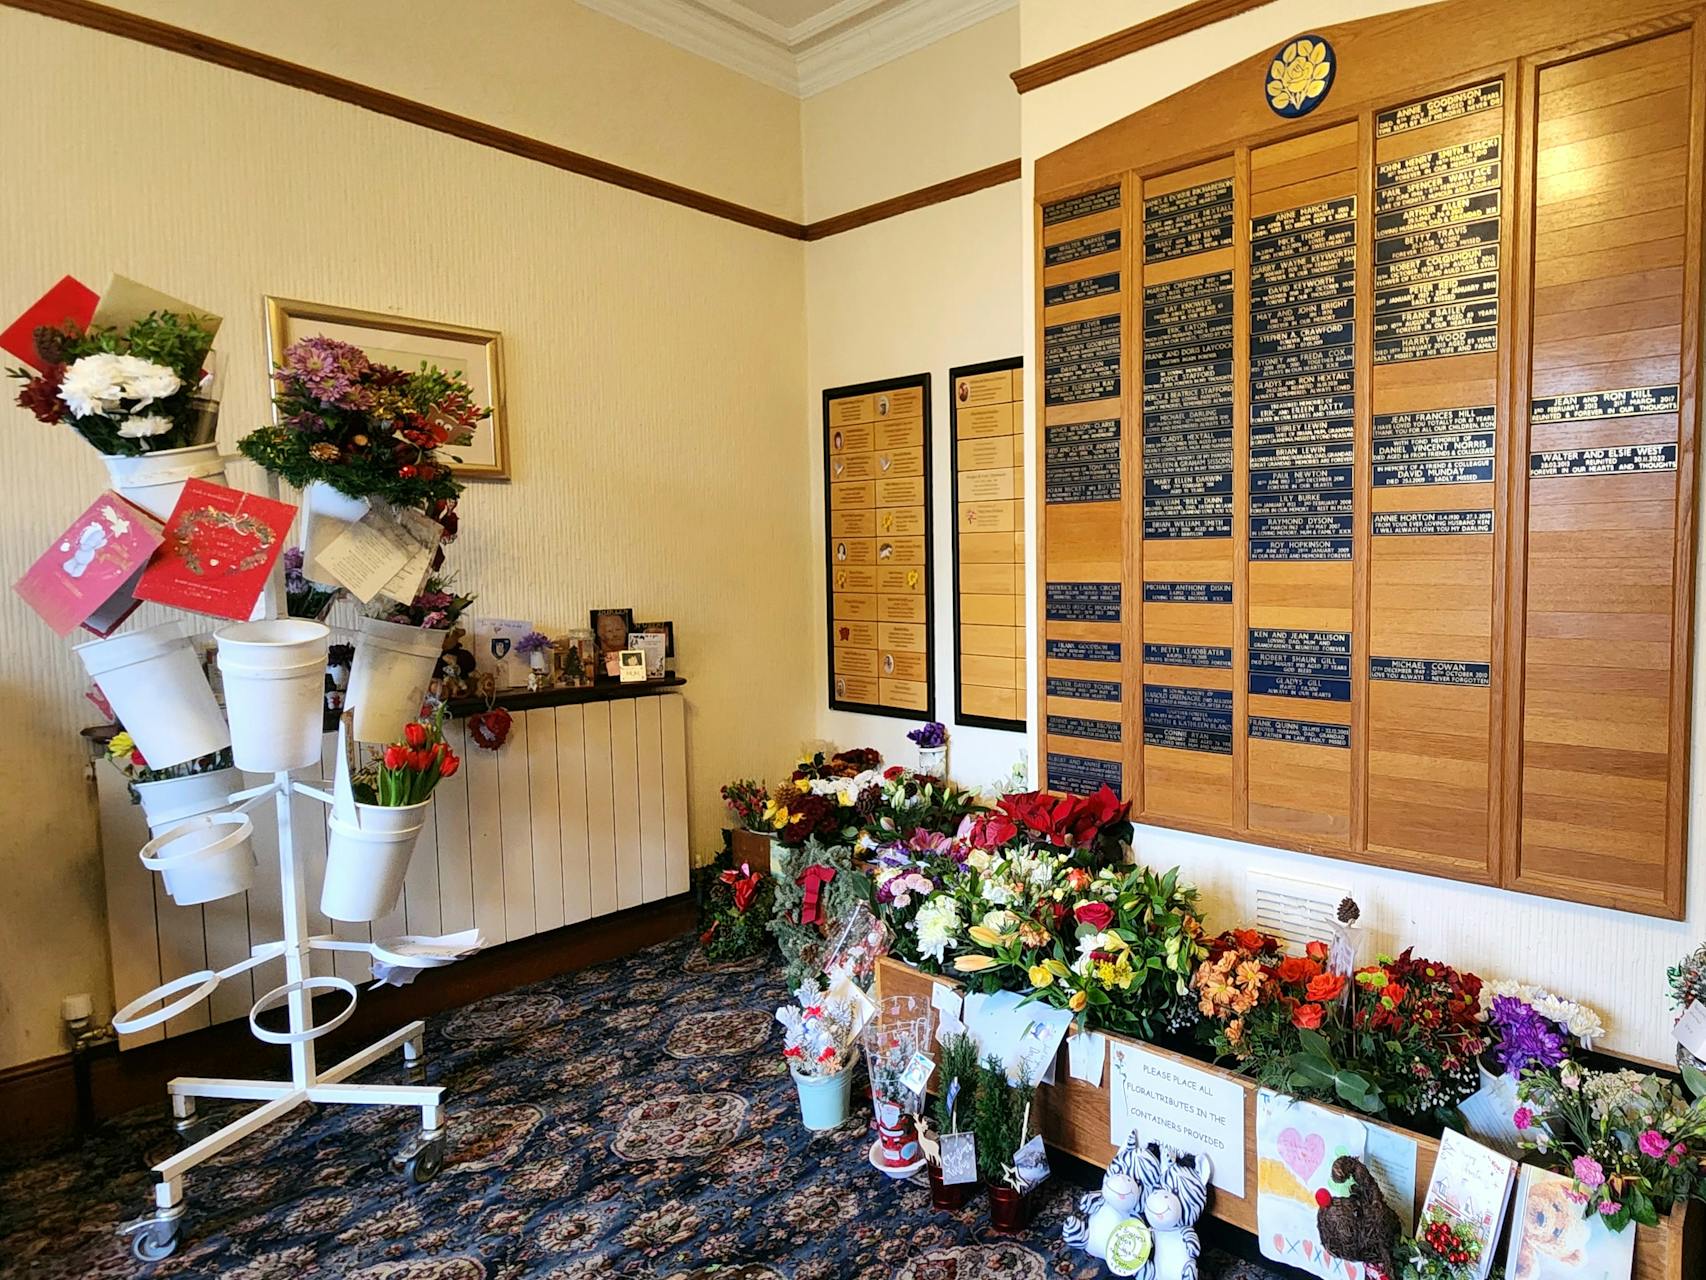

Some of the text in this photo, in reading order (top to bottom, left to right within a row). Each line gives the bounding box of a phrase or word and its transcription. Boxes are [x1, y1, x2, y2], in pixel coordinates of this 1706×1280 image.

[1397, 88, 1481, 119] ANNIE GOODINSON
[1380, 146, 1463, 174] JOHN HENRY SMITH
[1382, 167, 1491, 199] PAUL SPENCER WALLACE
[1276, 211, 1295, 221] ANNE
[1403, 198, 1470, 220] ARTHUR ALLEN
[1405, 226, 1467, 245] BETTY TRAVIS
[1280, 258, 1306, 269] WAYNE
[1311, 248, 1353, 263] KEYWORTH
[1390, 249, 1481, 273] ROBERT COLQUHOUN
[1268, 276, 1334, 294] DAVID KEYWORTH
[1410, 280, 1458, 295] PETER REID
[1277, 309, 1293, 318] AND
[1298, 305, 1317, 314] JOHN
[1321, 300, 1347, 310] BRIGHT
[1402, 305, 1466, 322] FRANK BAILEY
[1300, 324, 1343, 337] CRAWFORD
[1402, 331, 1466, 348] HARRY WOOD
[1329, 349, 1345, 357] COX
[1256, 372, 1349, 390] GLADYS RON HEXTALL
[1554, 397, 1577, 406] JEAN
[1604, 392, 1626, 401] RON
[1632, 389, 1652, 399] HILL
[1319, 403, 1343, 411] BATTY
[1533, 413, 1561, 421] REUNITED
[1640, 403, 1676, 411] THOUGHTS
[1548, 405, 1579, 413] FEBRUARY
[1391, 409, 1475, 424] JEAN FRANCES HILL
[1305, 422, 1327, 430] LEWIN
[1302, 446, 1326, 454] LEWIN
[1379, 439, 1487, 455] DANIEL VINCENT NORRIS
[1542, 447, 1663, 462] WALTER AND ELSIE WEST
[1295, 470, 1328, 478] NEWTON
[1398, 467, 1465, 478] DAVID MUNDAY
[1400, 513, 1435, 521] HORTON
[1392, 661, 1465, 671] MICHAEL COWAN
[1143, 1064, 1213, 1096] PLEASE PLACE ALL
[1197, 1108, 1207, 1118] IN
[1210, 1113, 1226, 1125] THE
[1131, 1107, 1224, 1150] CONTAINERS PROVIDED
